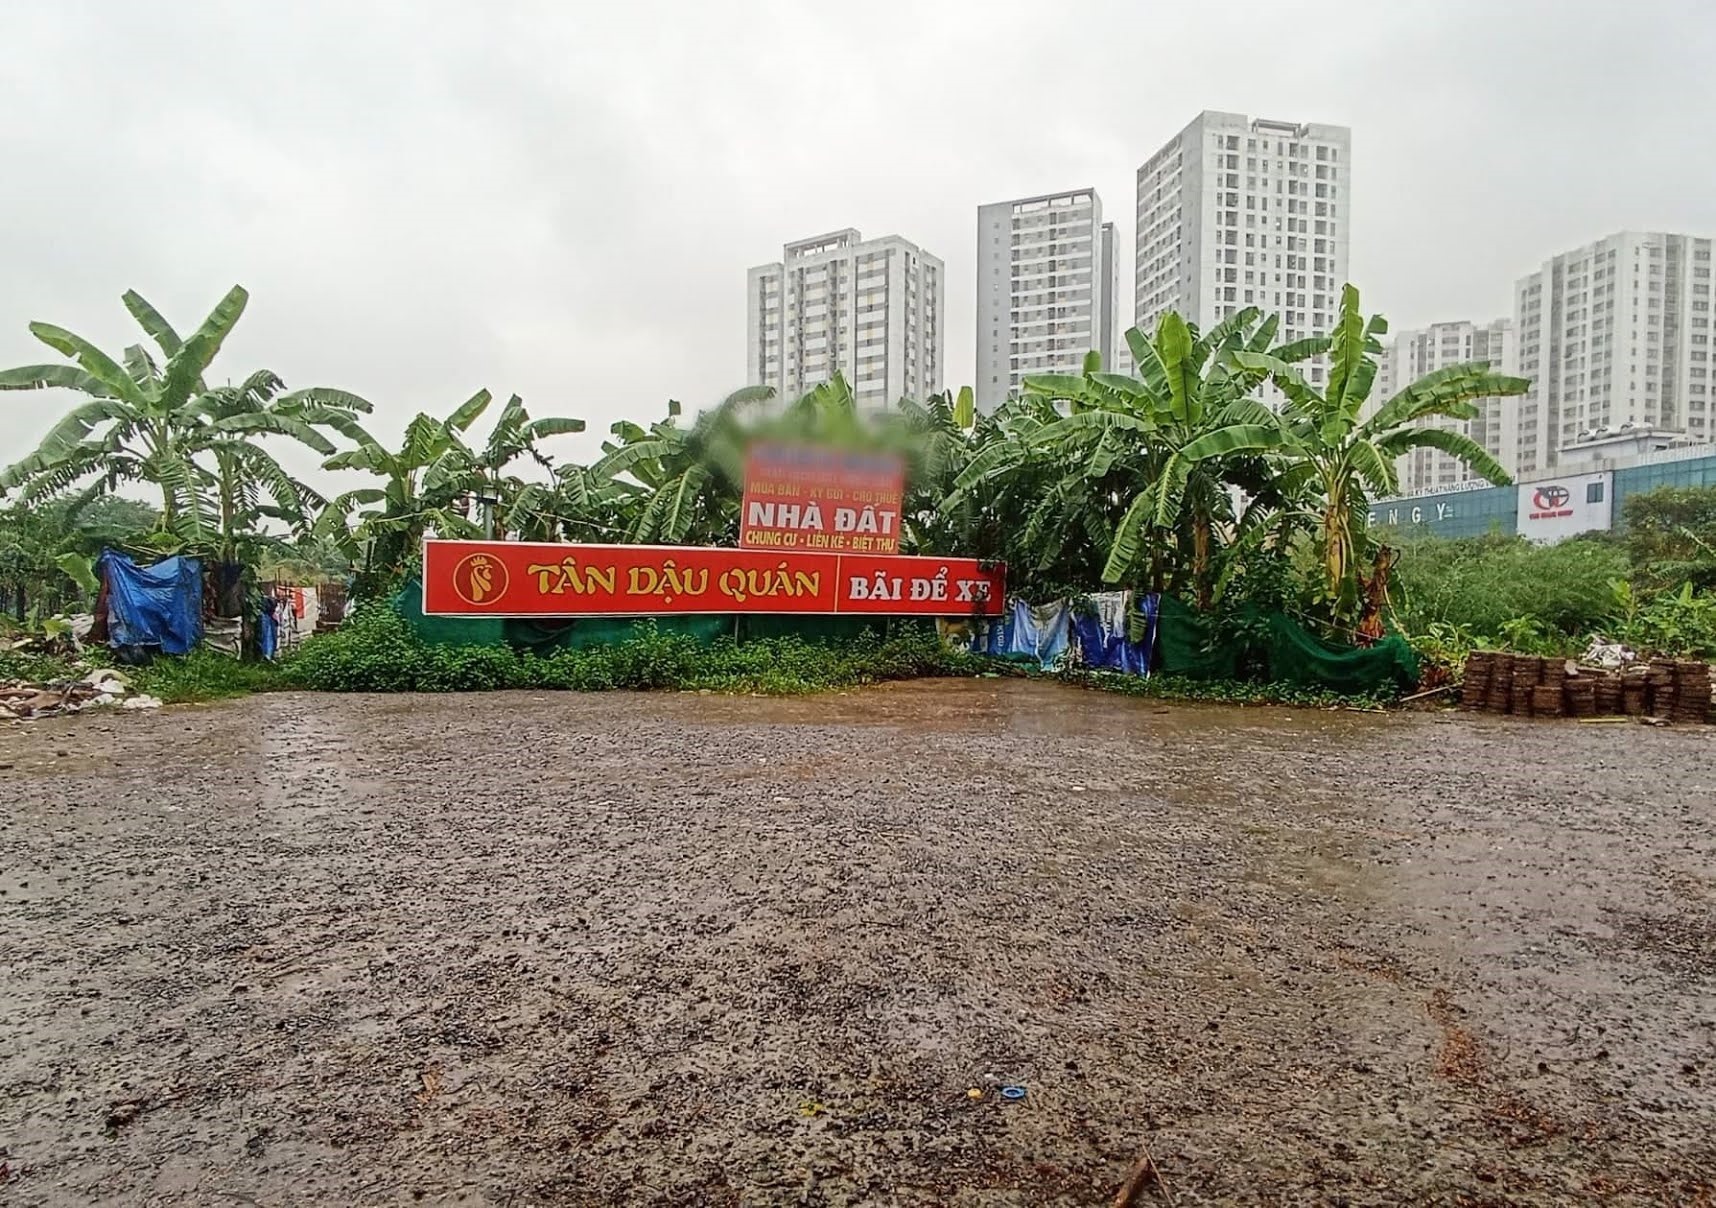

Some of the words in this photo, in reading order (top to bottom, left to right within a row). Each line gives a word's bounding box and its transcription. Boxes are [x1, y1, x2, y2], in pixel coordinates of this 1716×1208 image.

[748, 501, 823, 531] NHÀ
[834, 502, 896, 534] ĐẤT
[745, 530, 782, 546] CHUNG
[783, 532, 798, 546] CƯ
[852, 534, 874, 552] BIỆT
[876, 537, 896, 553] THỰ
[527, 556, 616, 595] TÂN
[626, 559, 709, 604] DẬU
[718, 561, 820, 603] QUÁN
[850, 571, 903, 600] BÃI
[910, 567, 949, 601] ĐỂ
[955, 580, 991, 602] XE
